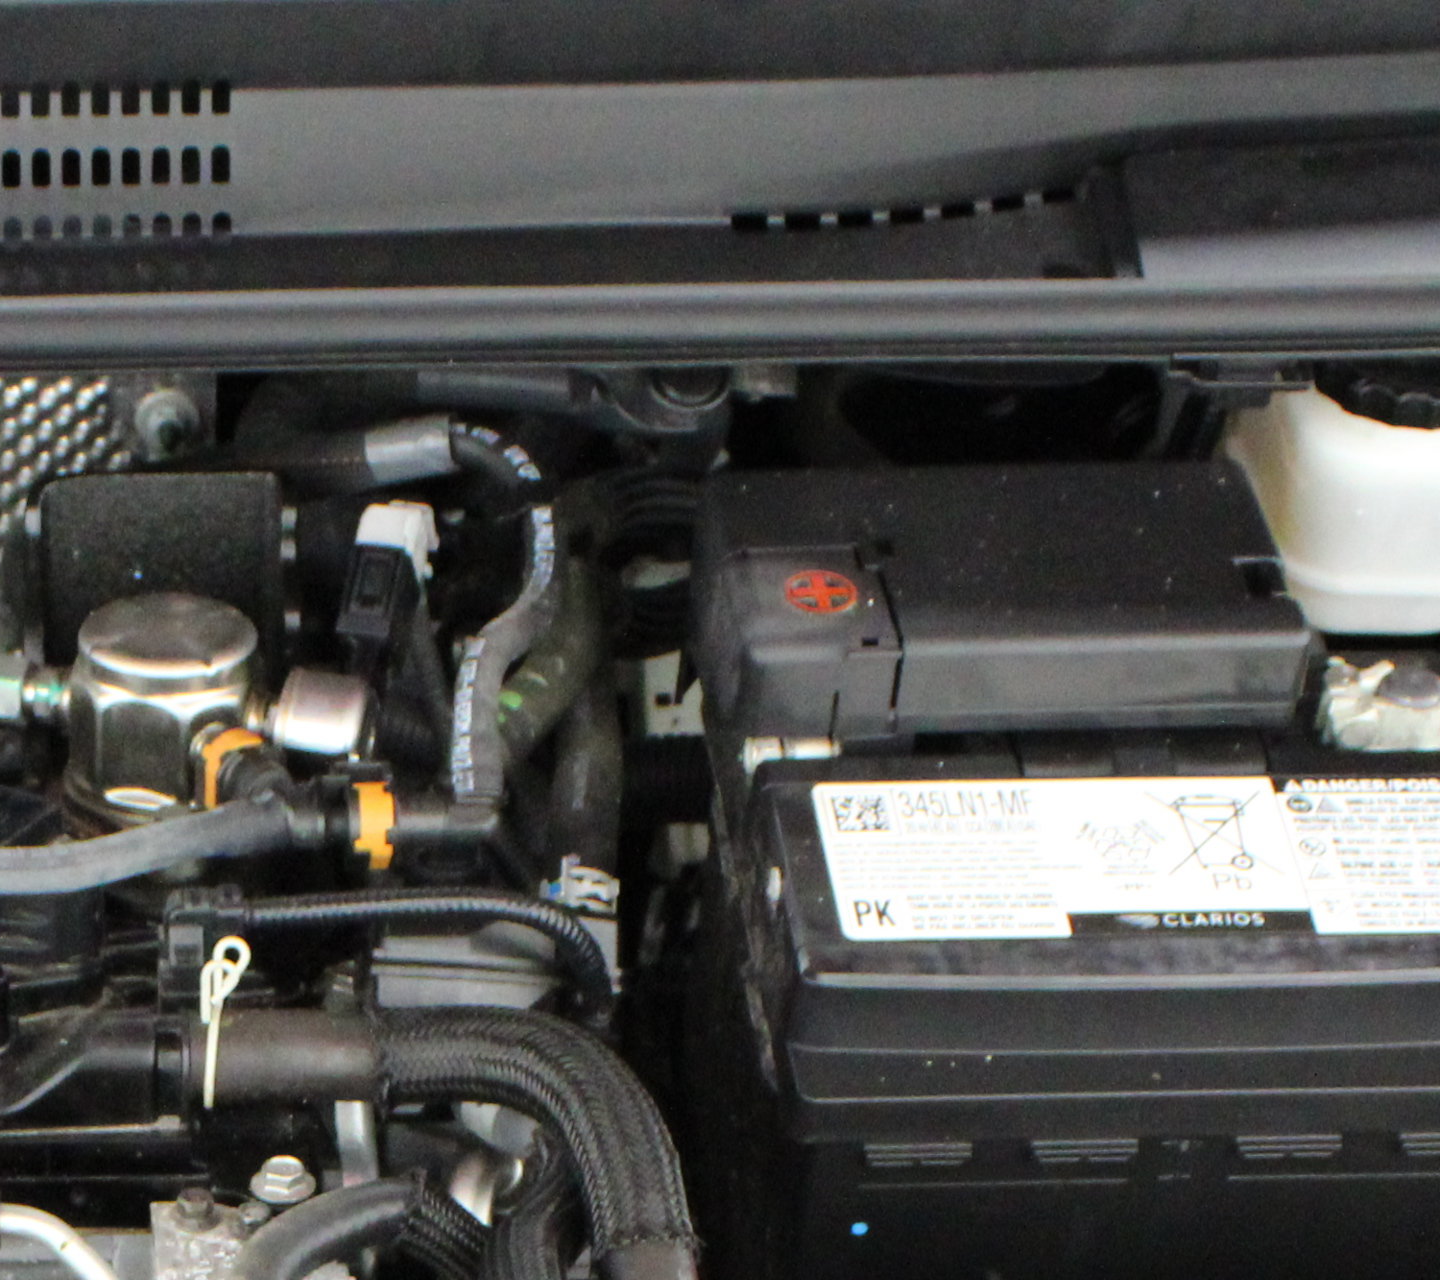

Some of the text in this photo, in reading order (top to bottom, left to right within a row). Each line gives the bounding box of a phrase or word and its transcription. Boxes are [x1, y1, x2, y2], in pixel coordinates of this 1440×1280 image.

[898, 789, 1033, 818] 345LN1-MF
[1212, 873, 1253, 890] Pb
[854, 900, 896, 927] PK
[1161, 912, 1265, 928] CLARIOS
